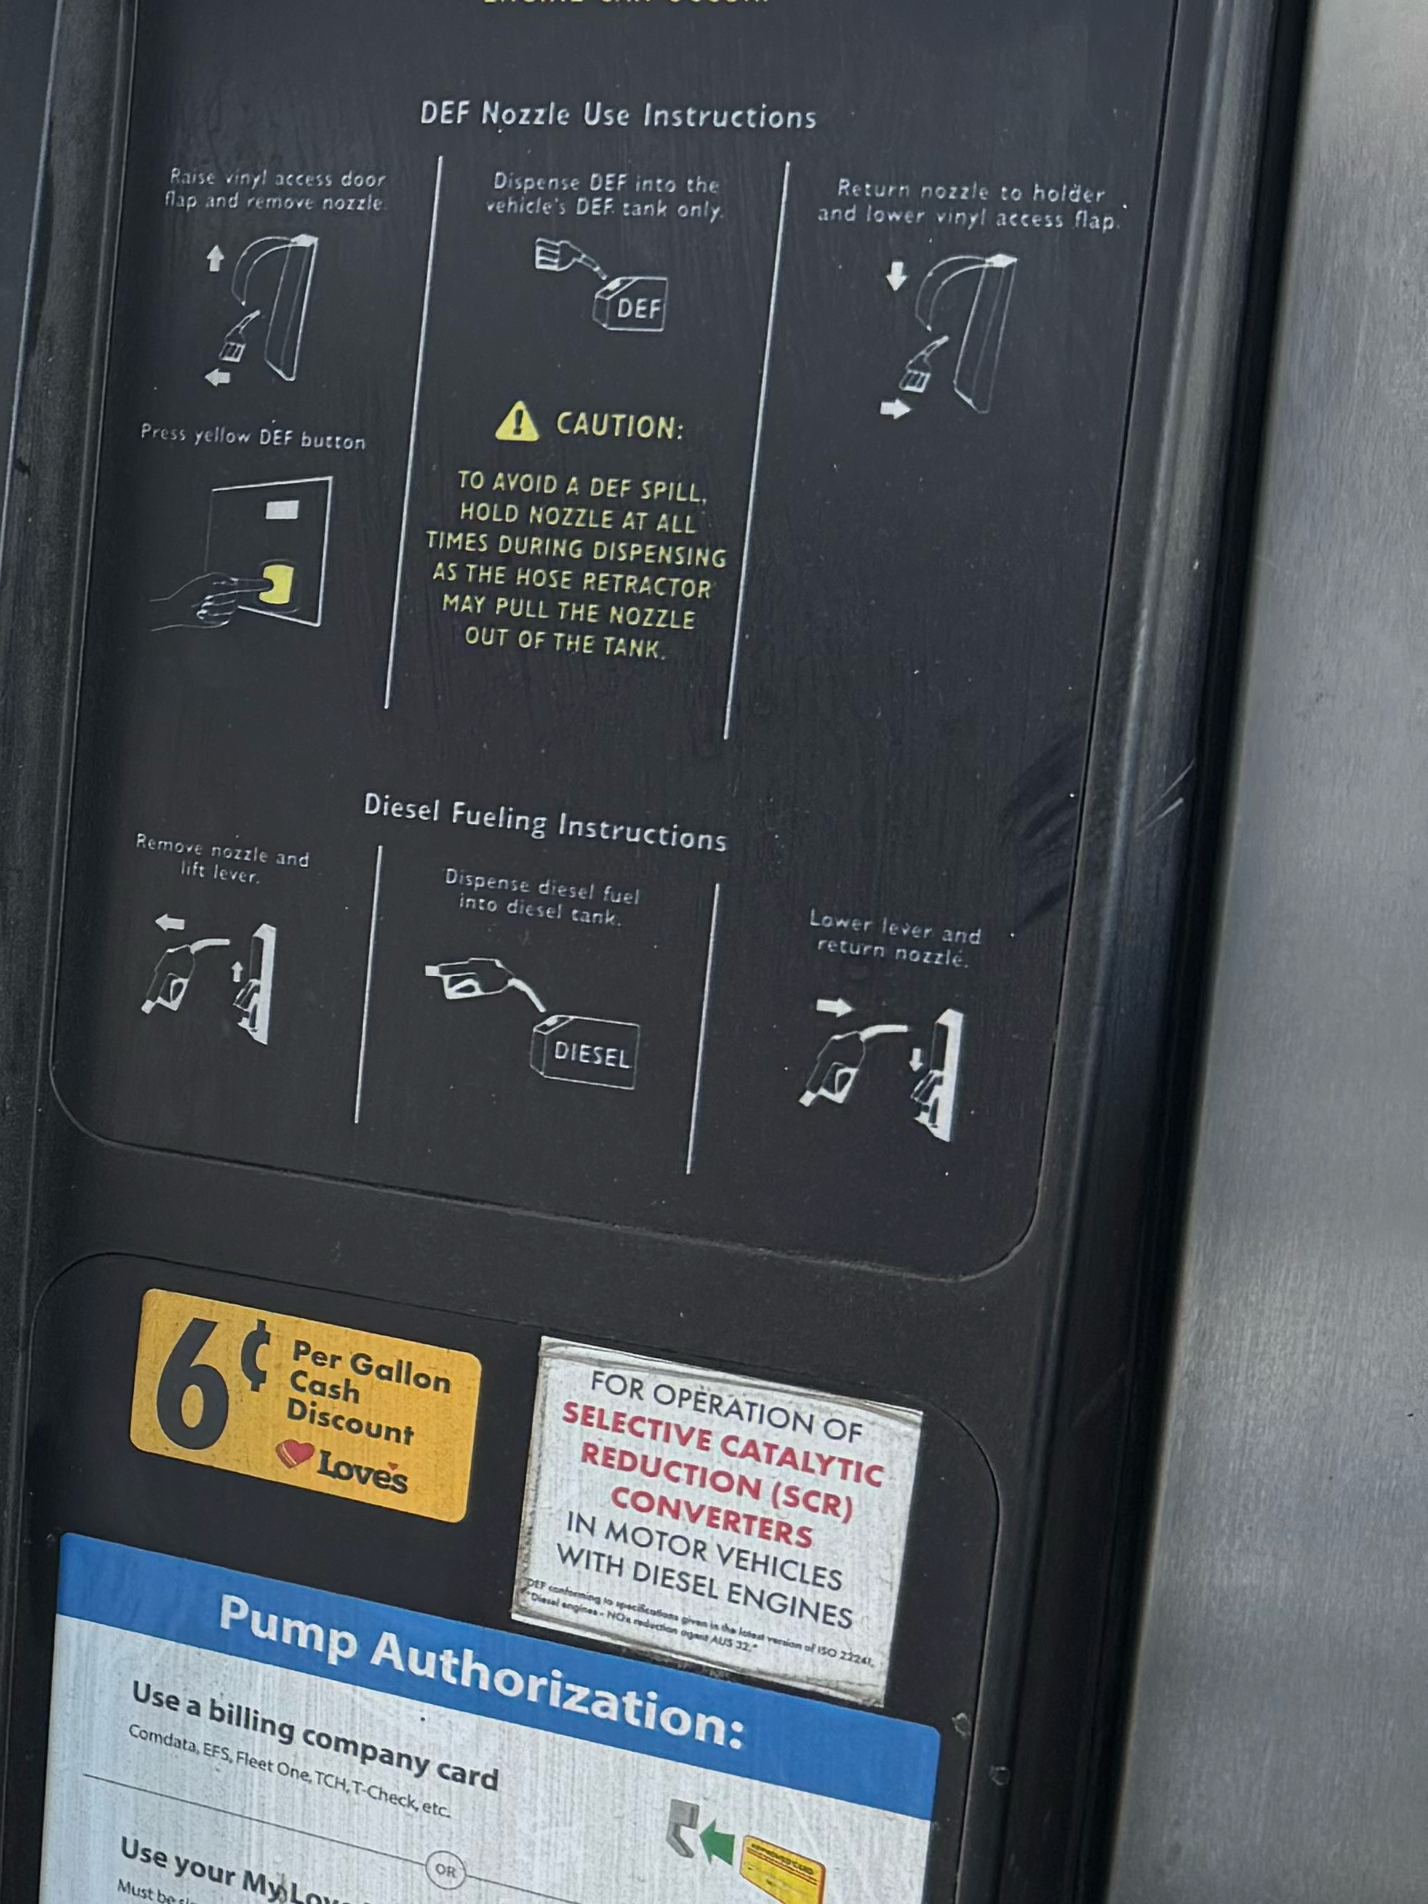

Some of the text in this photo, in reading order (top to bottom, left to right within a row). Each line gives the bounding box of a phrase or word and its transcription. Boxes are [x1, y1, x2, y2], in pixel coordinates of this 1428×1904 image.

[421, 100, 818, 130] DEF Nozzle Use Instructions
[141, 423, 366, 450] Press yellow DEF button
[556, 411, 684, 440] CAUTION:
[364, 793, 728, 853] Diesel Fueling Instructions
[554, 1040, 631, 1069] DIESEL
[290, 1370, 360, 1404] Cash
[292, 1339, 342, 1369] Per
[350, 1352, 451, 1394] Gallon
[287, 1397, 414, 1446] Discount
[591, 1370, 863, 1444] FOR OPERATION OF
[562, 1401, 885, 1488] SELECTIVE CATALYTIC
[580, 1441, 853, 1524] REDUCTION (SCR)
[611, 1486, 813, 1549] CONVERTERS
[567, 1511, 843, 1591] IN MOTOR VEHICLES
[556, 1543, 854, 1630] WITH DIESEL ENGINES
[219, 1593, 746, 1751] Pump Authorization:
[132, 1680, 500, 1792] Use a billing company card
